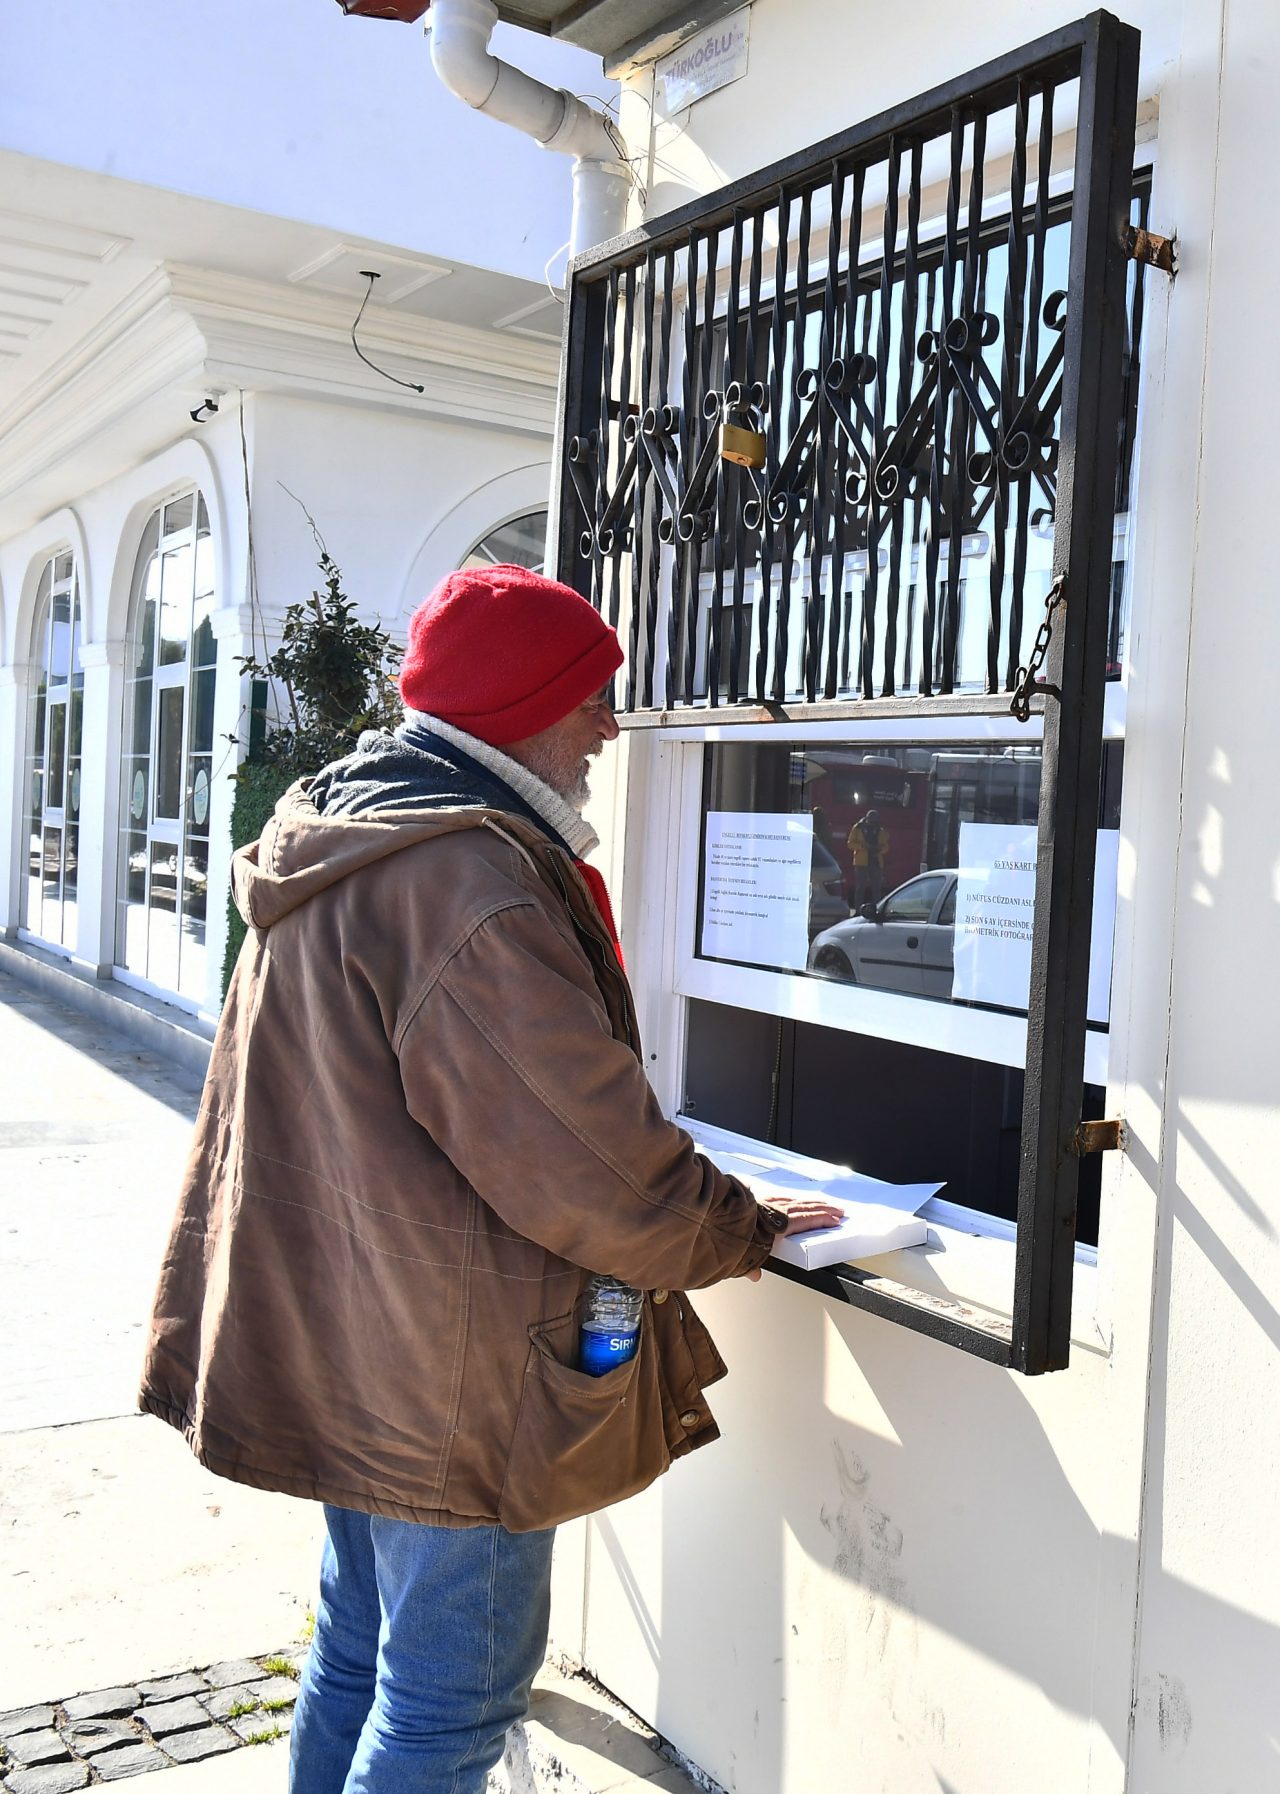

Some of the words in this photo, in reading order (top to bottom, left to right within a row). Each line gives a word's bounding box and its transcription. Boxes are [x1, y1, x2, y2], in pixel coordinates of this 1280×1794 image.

[1014, 862, 1032, 871] KART
[992, 895, 1021, 906] CÜZDANI
[989, 918, 997, 926] AY
